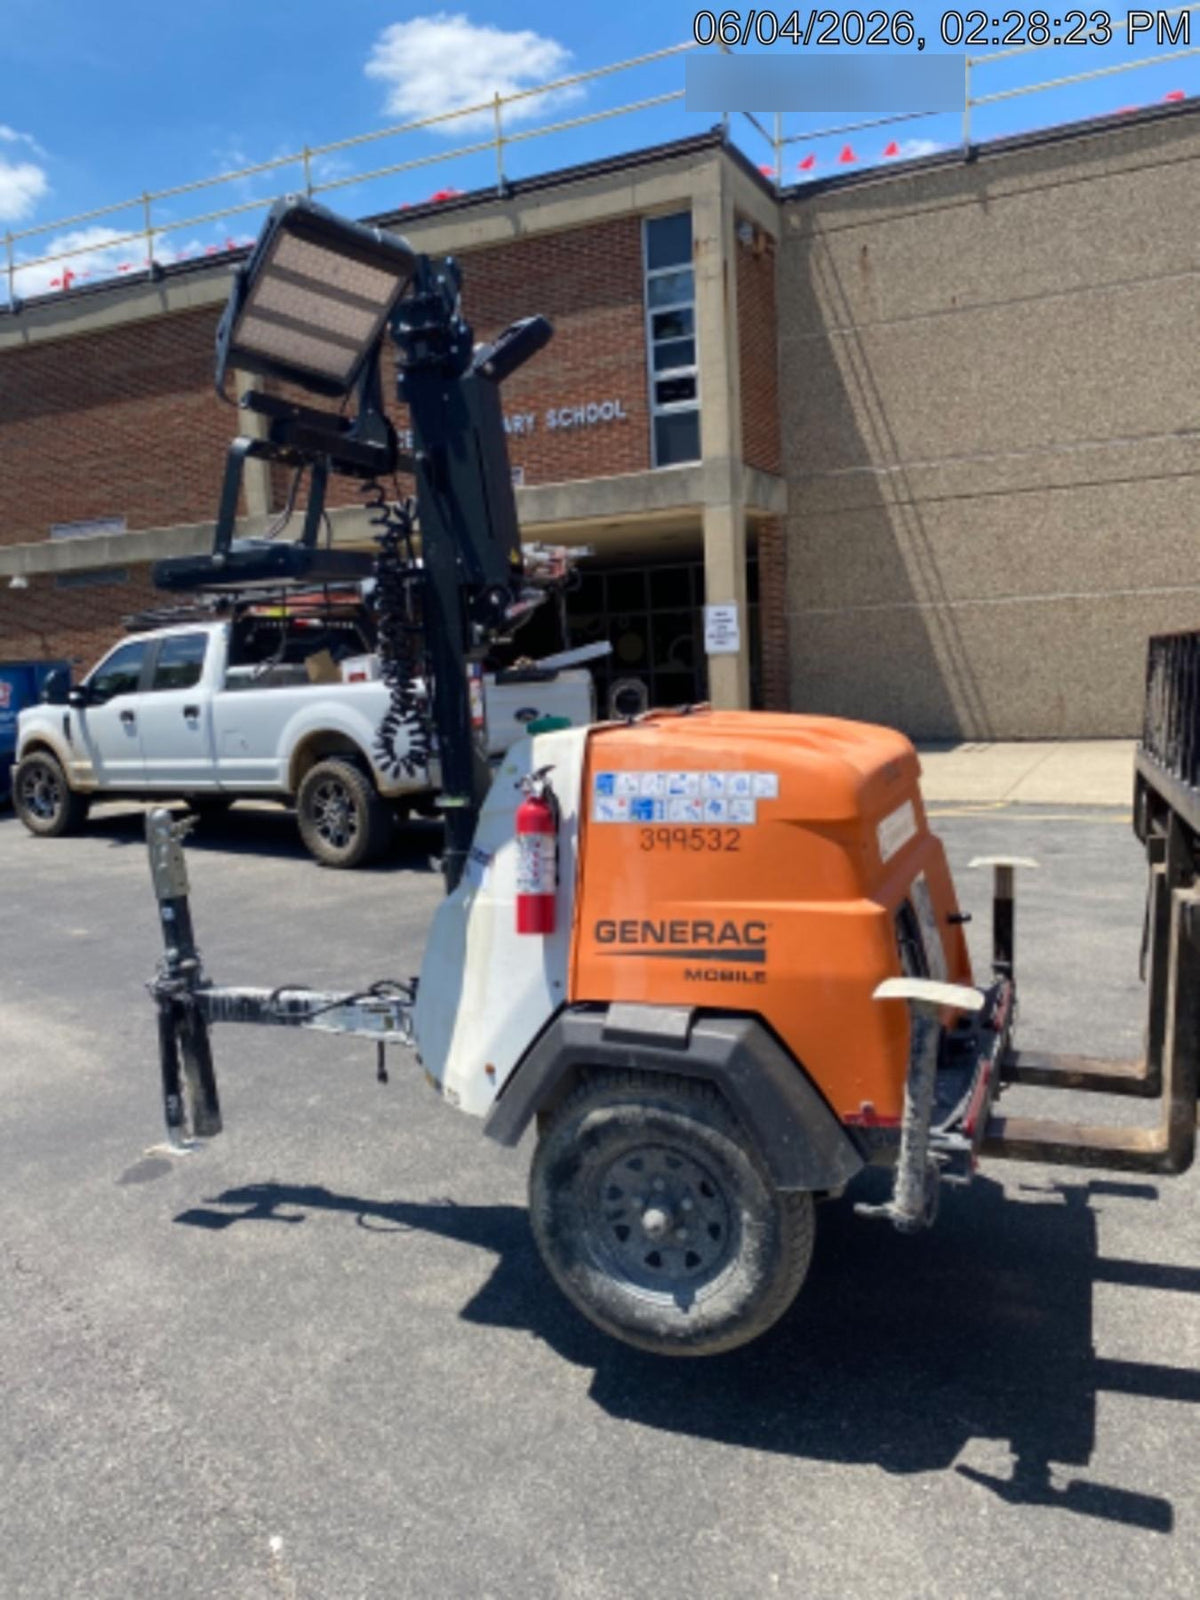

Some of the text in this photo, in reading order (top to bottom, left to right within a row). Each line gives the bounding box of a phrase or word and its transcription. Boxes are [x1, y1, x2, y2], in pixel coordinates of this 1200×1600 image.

[546, 399, 627, 429] SCHOOL
[639, 827, 741, 852] 399532
[594, 919, 767, 945] GENERAC
[684, 967, 767, 984] MOBILE
